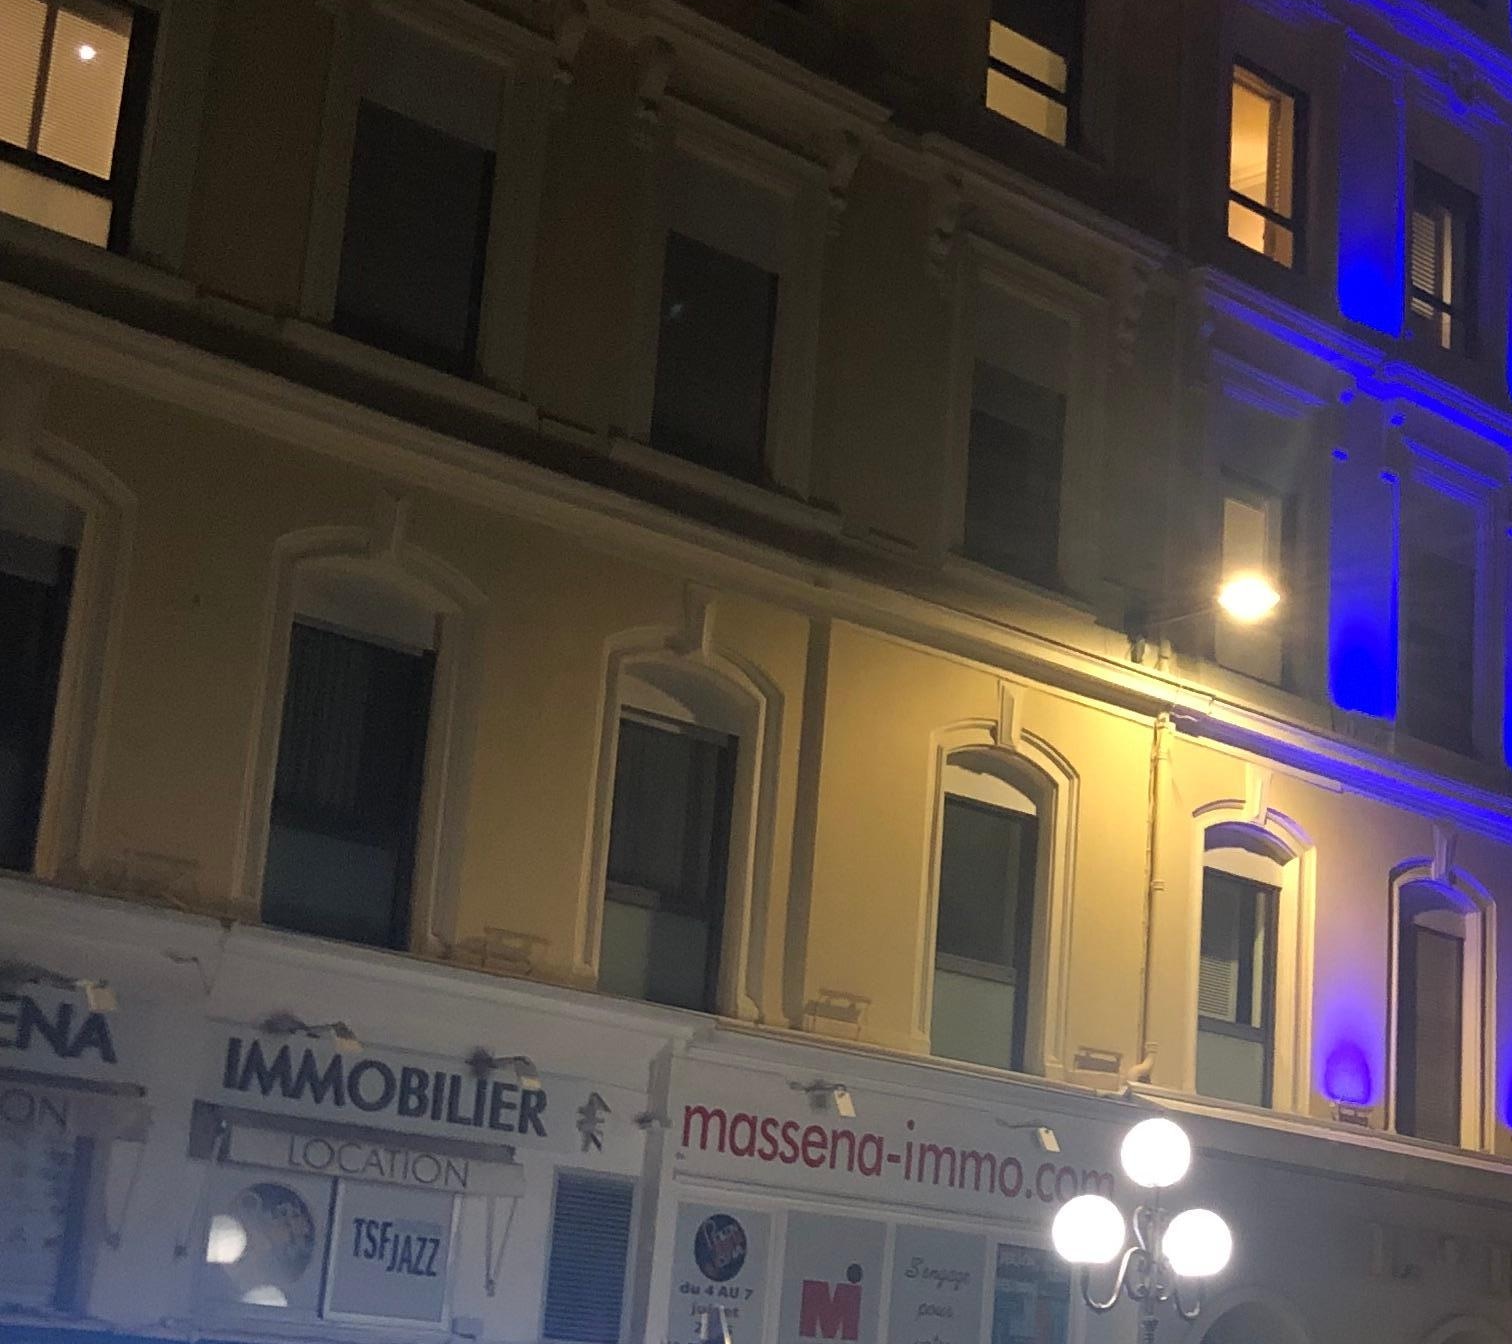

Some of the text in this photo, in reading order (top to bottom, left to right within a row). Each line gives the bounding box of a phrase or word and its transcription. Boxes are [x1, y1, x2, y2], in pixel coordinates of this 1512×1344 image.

[222, 1036, 548, 1137] IMMOBILIER
[288, 1135, 471, 1189] LOCATION
[680, 1104, 1116, 1204] massena-immo.com
[717, 1286, 740, 1299] AU
